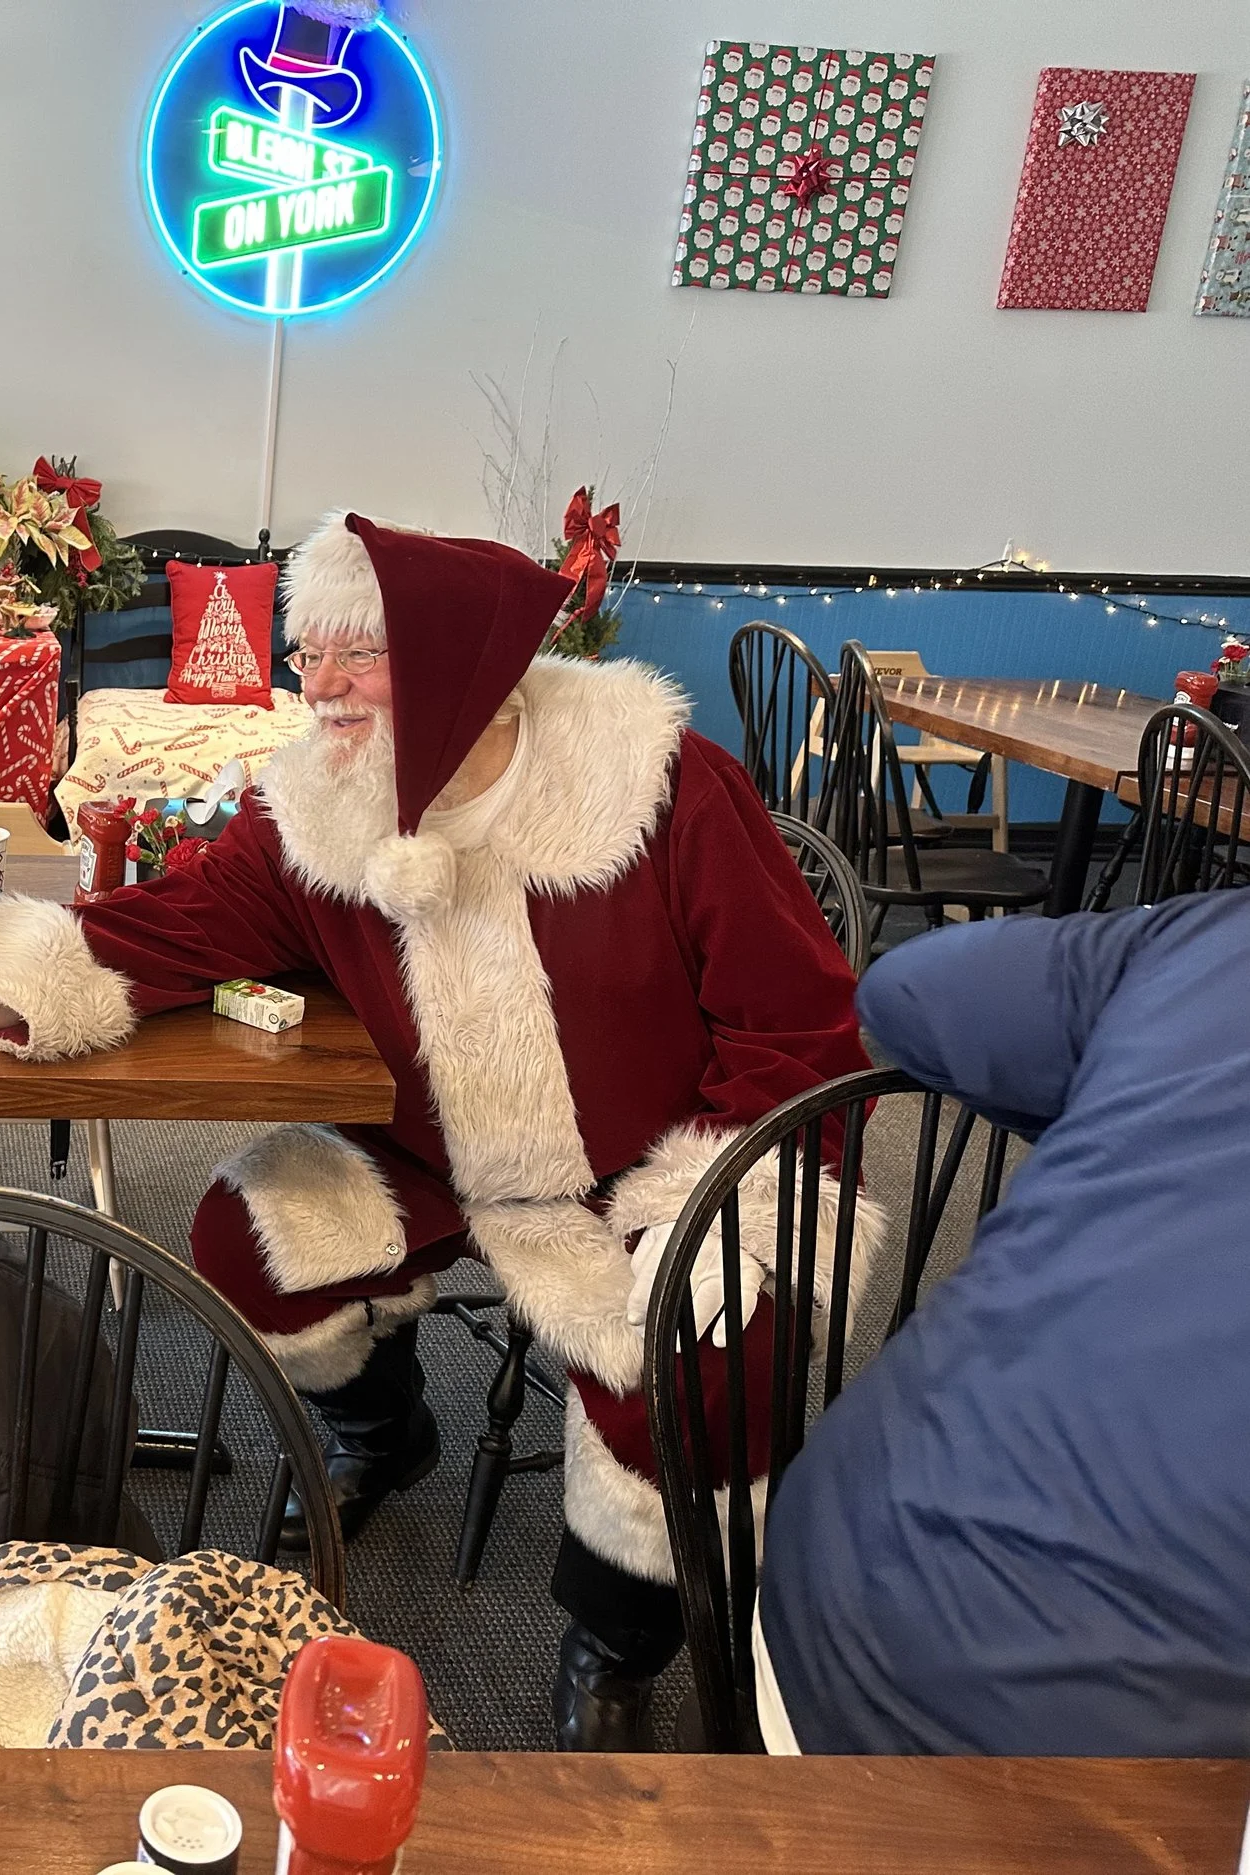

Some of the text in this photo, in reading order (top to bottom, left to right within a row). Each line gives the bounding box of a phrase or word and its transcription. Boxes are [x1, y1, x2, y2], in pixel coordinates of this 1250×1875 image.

[224, 180, 357, 250] ON YORK
[206, 599, 235, 623] very
[198, 617, 243, 643] Merry
[188, 641, 256, 665] Christmas
[180, 668, 215, 688] Happy
[216, 671, 237, 682] New
